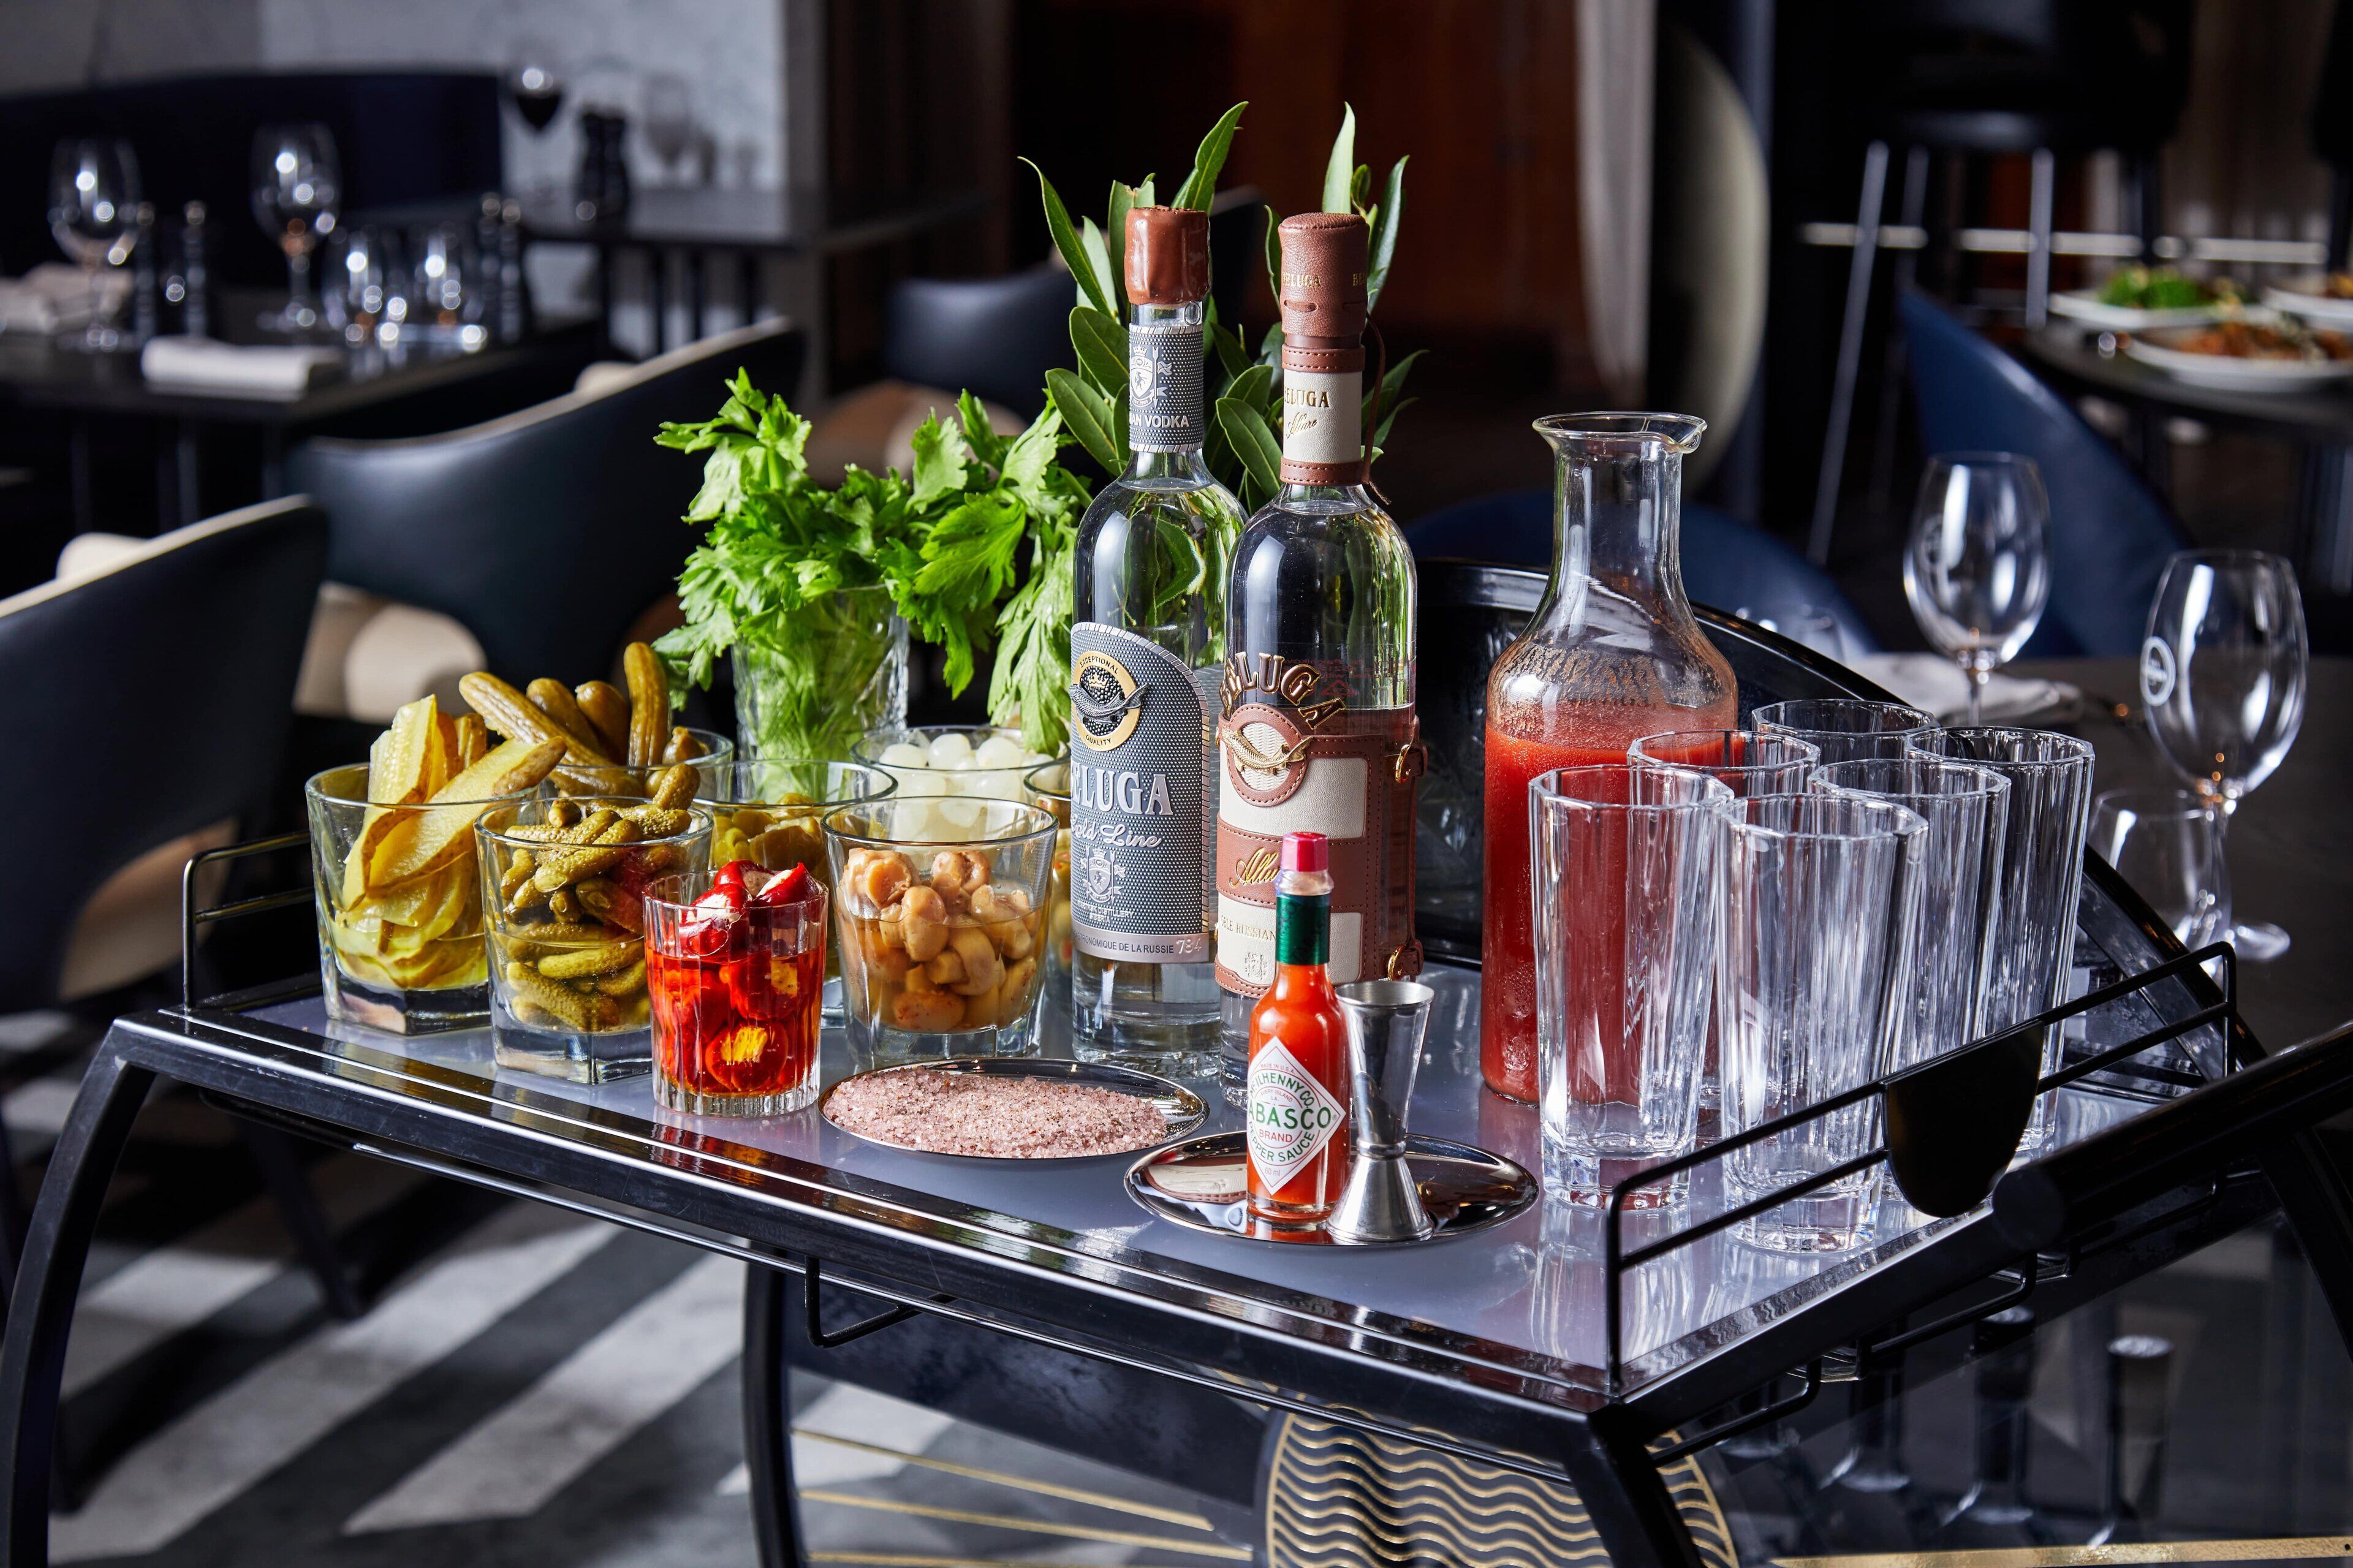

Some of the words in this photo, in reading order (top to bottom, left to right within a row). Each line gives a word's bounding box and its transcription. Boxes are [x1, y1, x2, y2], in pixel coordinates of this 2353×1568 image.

[1285, 387, 1329, 407] ELUGA
[1144, 415, 1189, 428] VODKA
[1080, 656, 1118, 675] EXCEPTIONAL
[1085, 735, 1112, 746] QUALITY
[1070, 761, 1173, 816] ELUGA
[1100, 824, 1162, 848] Line
[1229, 847, 1281, 888] Allu
[1098, 907, 1134, 918] DISTILLERY
[1119, 943, 1129, 952] DE
[1131, 944, 1142, 953] LA
[1143, 945, 1174, 954] RUSSIE
[1275, 1089, 1293, 1102] ISLAND
[1249, 1121, 1275, 1162] PEPPER
[1278, 1131, 1315, 1162] SAUCE
[1259, 1129, 1293, 1143] BRAND
[1265, 1167, 1271, 1175] 60
